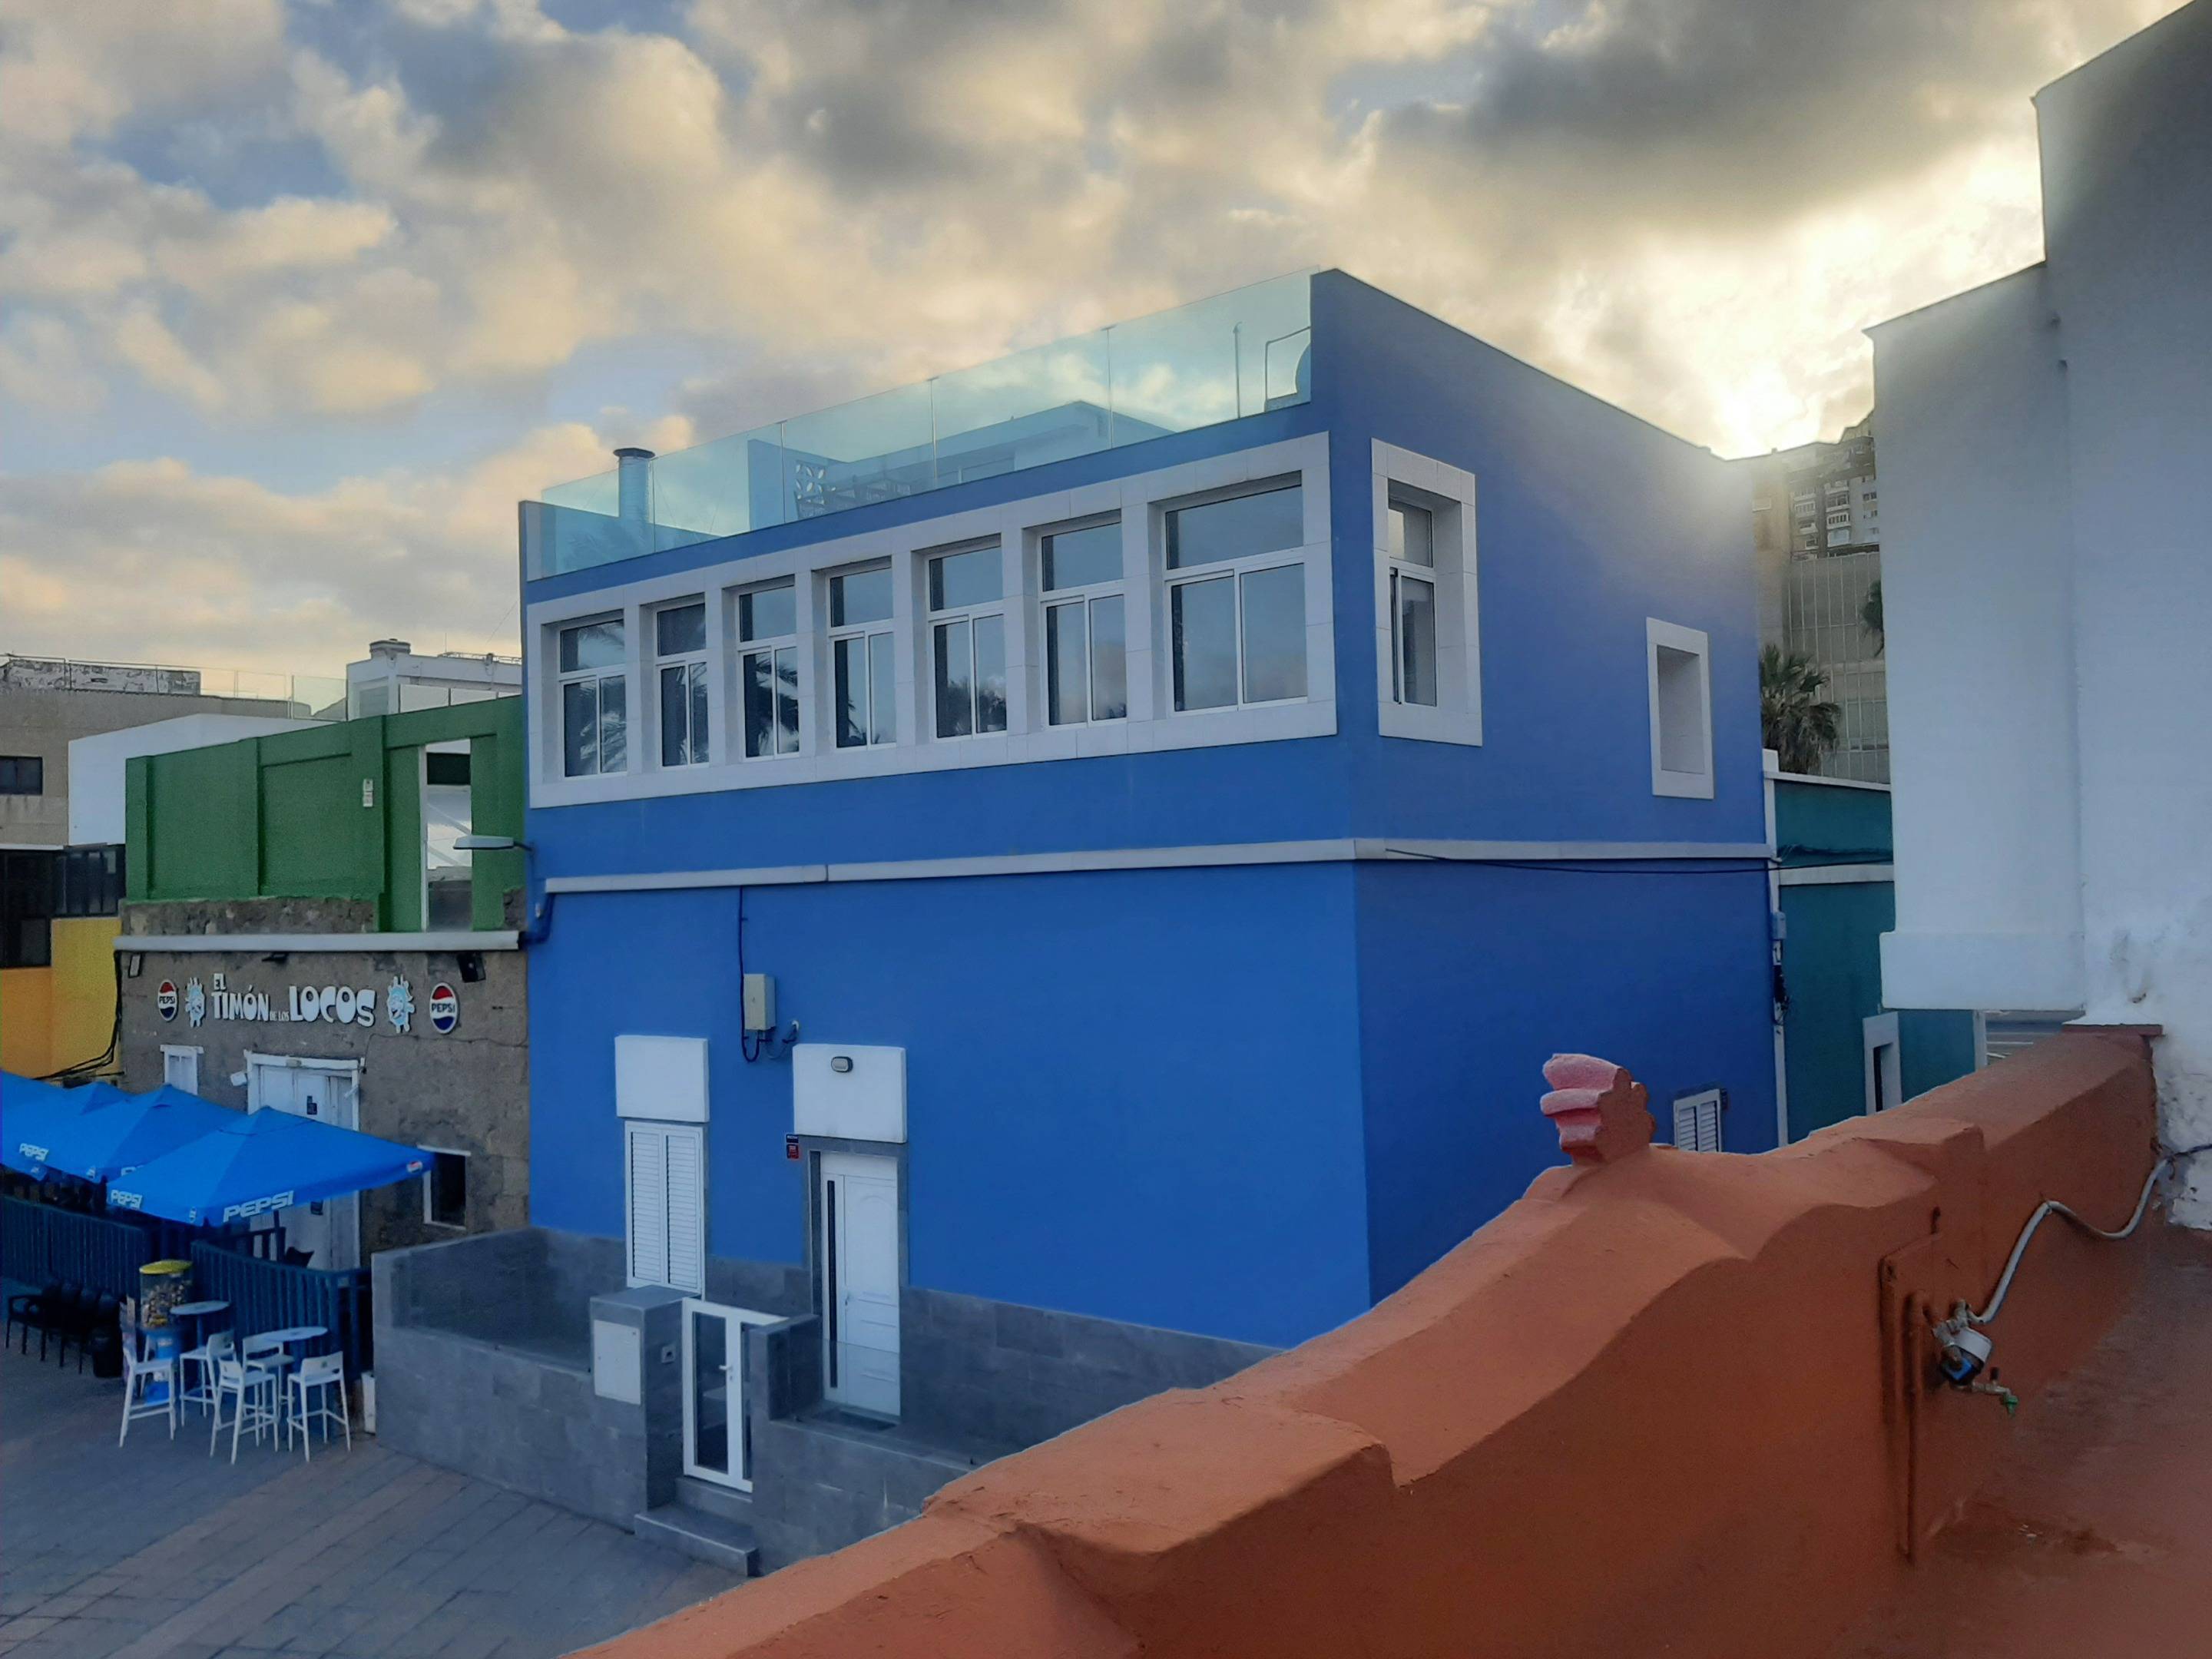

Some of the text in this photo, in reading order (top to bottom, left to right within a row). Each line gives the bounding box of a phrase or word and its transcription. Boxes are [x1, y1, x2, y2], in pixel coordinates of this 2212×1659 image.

[213, 973, 226, 991] EL
[159, 995, 176, 1004] PEPSI
[211, 985, 269, 1022] TIMÓN
[289, 985, 376, 1028] LOCOS
[431, 1002, 455, 1013] PEPSI
[19, 1143, 49, 1161] PEPSI
[111, 1190, 143, 1209] PEPSI
[223, 1190, 294, 1223] PEPSI
